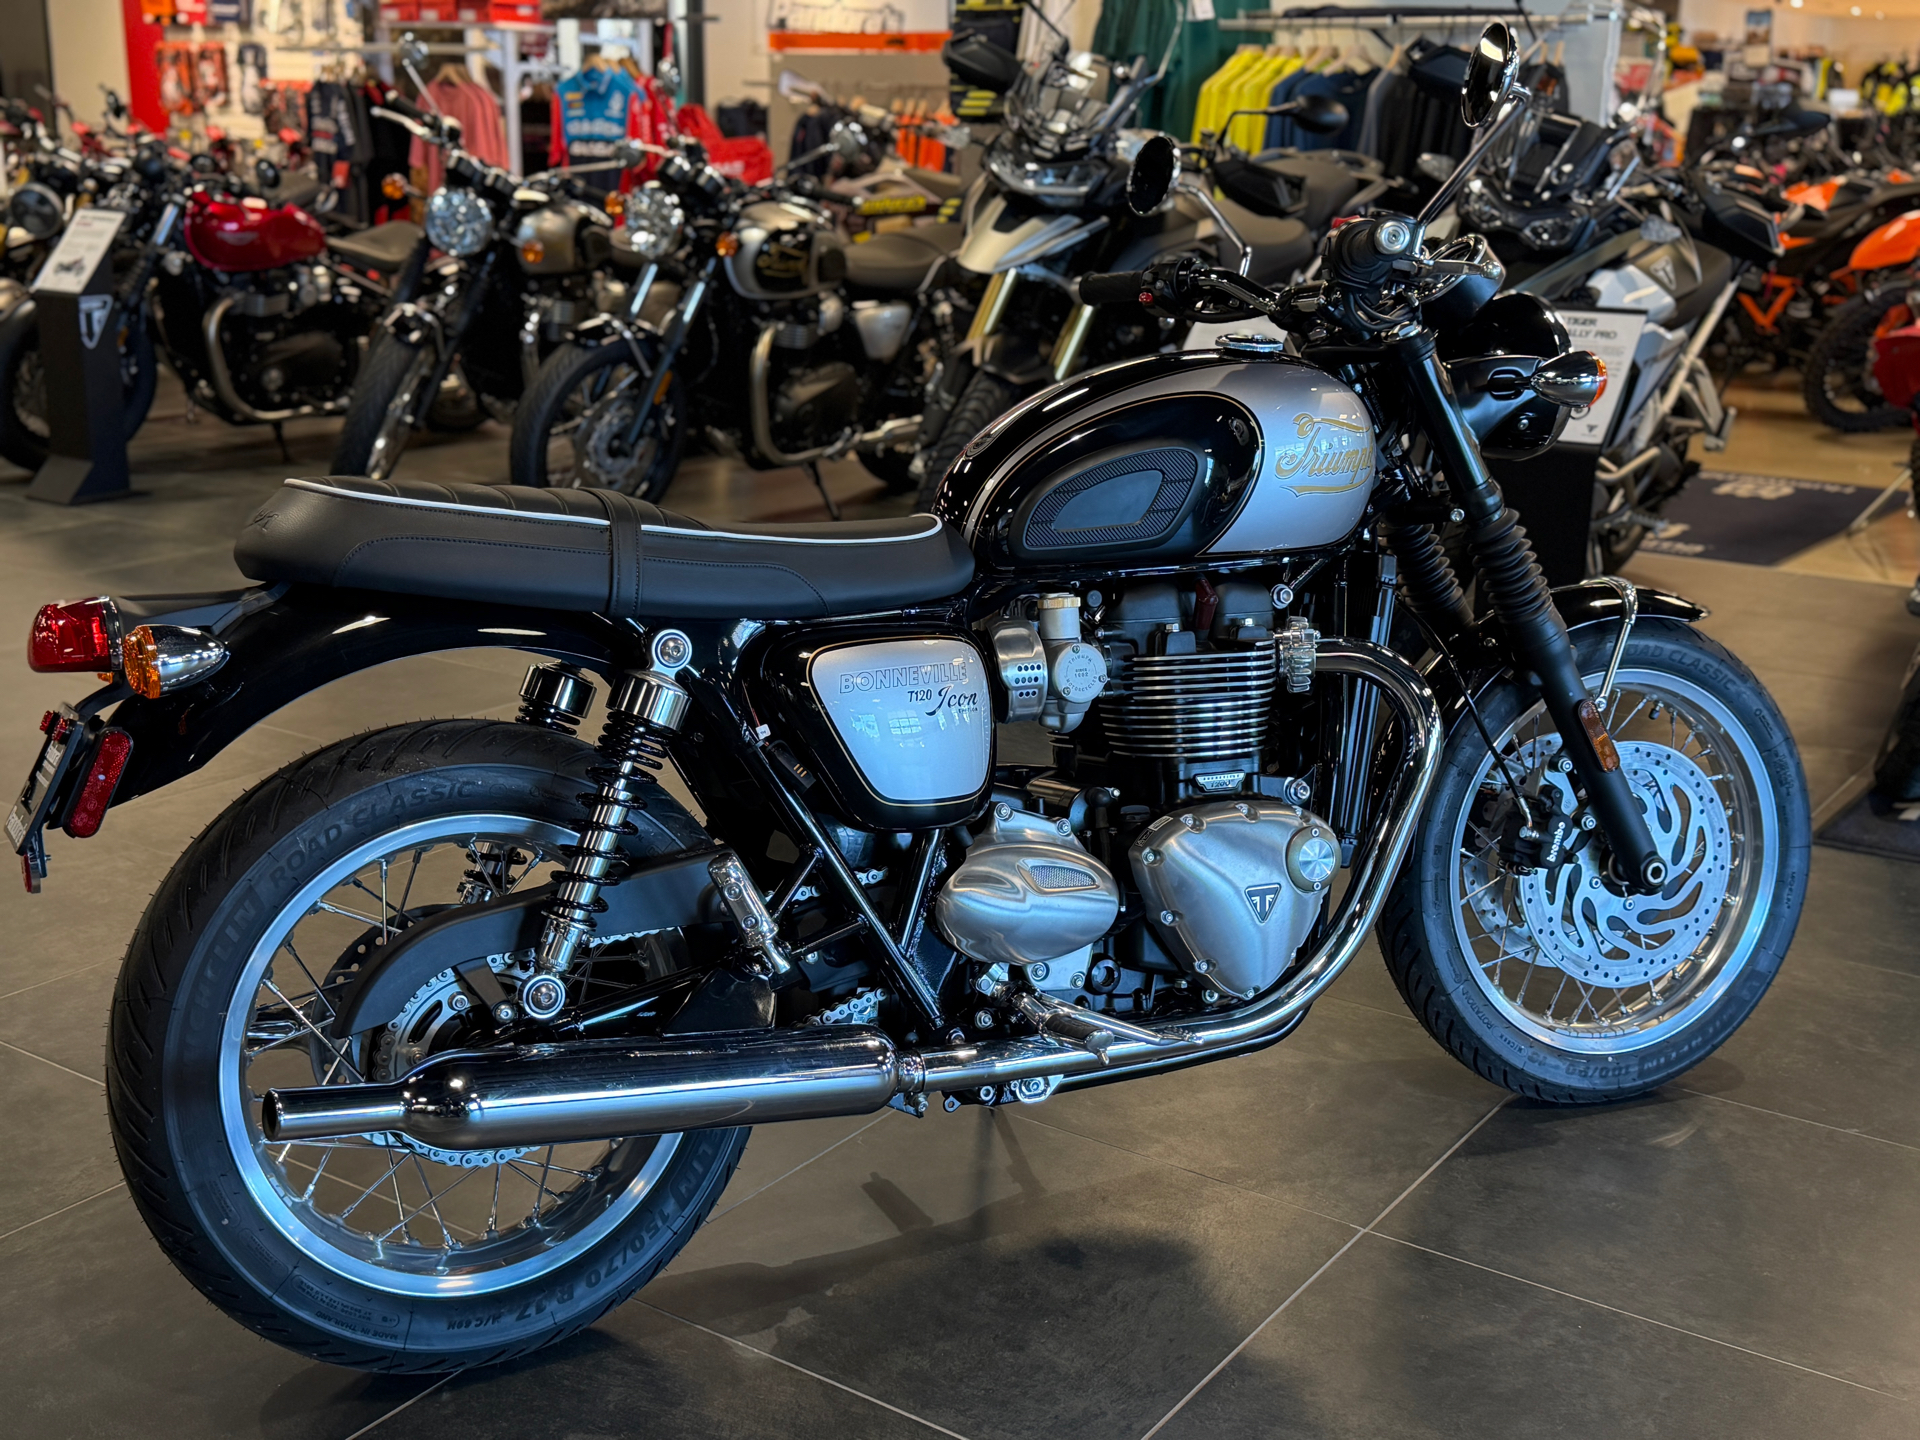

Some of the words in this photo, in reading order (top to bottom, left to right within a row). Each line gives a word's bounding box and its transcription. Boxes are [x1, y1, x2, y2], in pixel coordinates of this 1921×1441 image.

[1594, 329, 1618, 340] PRO
[839, 660, 968, 694] BONNEVILLE
[1625, 643, 1664, 658] OAD
[1668, 649, 1738, 690] CLASSIC
[907, 689, 933, 703] T120
[925, 684, 978, 717] Icon
[268, 822, 345, 890] ROAD
[351, 779, 477, 830] CLASSIC
[1546, 821, 1567, 863] brembo
[585, 1207, 670, 1290] 150/70
[514, 1290, 548, 1323] 17
[556, 1285, 576, 1305] R
[314, 1308, 357, 1332] THAILAND
[360, 1325, 371, 1335] IN
[371, 1328, 399, 1342] MADE
